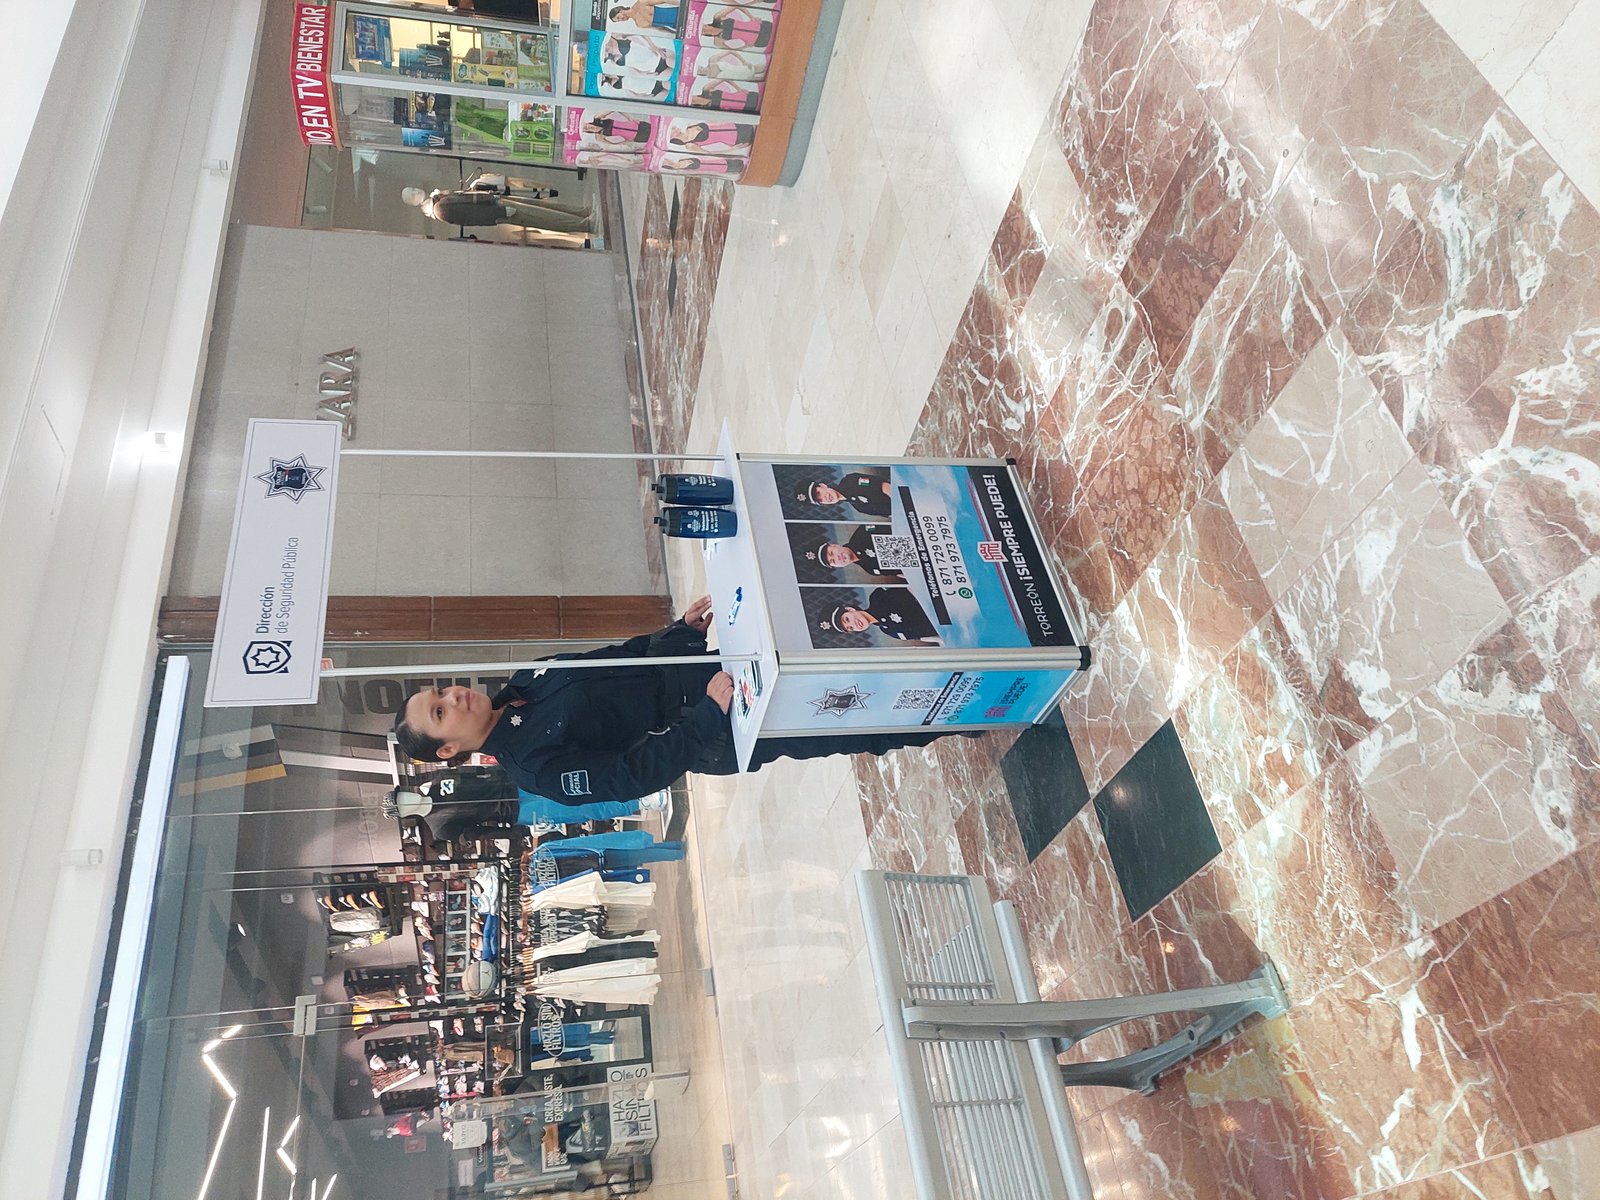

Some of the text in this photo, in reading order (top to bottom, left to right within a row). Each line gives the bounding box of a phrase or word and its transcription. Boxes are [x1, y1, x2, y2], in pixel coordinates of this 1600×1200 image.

[296, 7, 326, 72] BIENESTAR
[296, 74, 325, 99] TV
[301, 104, 330, 128] EN
[982, 473, 1009, 519] PUEDE!
[907, 511, 940, 598] Teléfonos de Emergencia
[922, 515, 953, 585] 871 729 0099
[936, 515, 967, 583] 871 973 7975
[1000, 521, 1033, 581] ¡SIEMPRE
[274, 537, 299, 634] de Seguridad Pública
[255, 586, 275, 634] Dirección
[947, 694, 960, 704] 729
[440, 779, 455, 796] 23
[541, 1005, 553, 1051] HAZLO SIN
